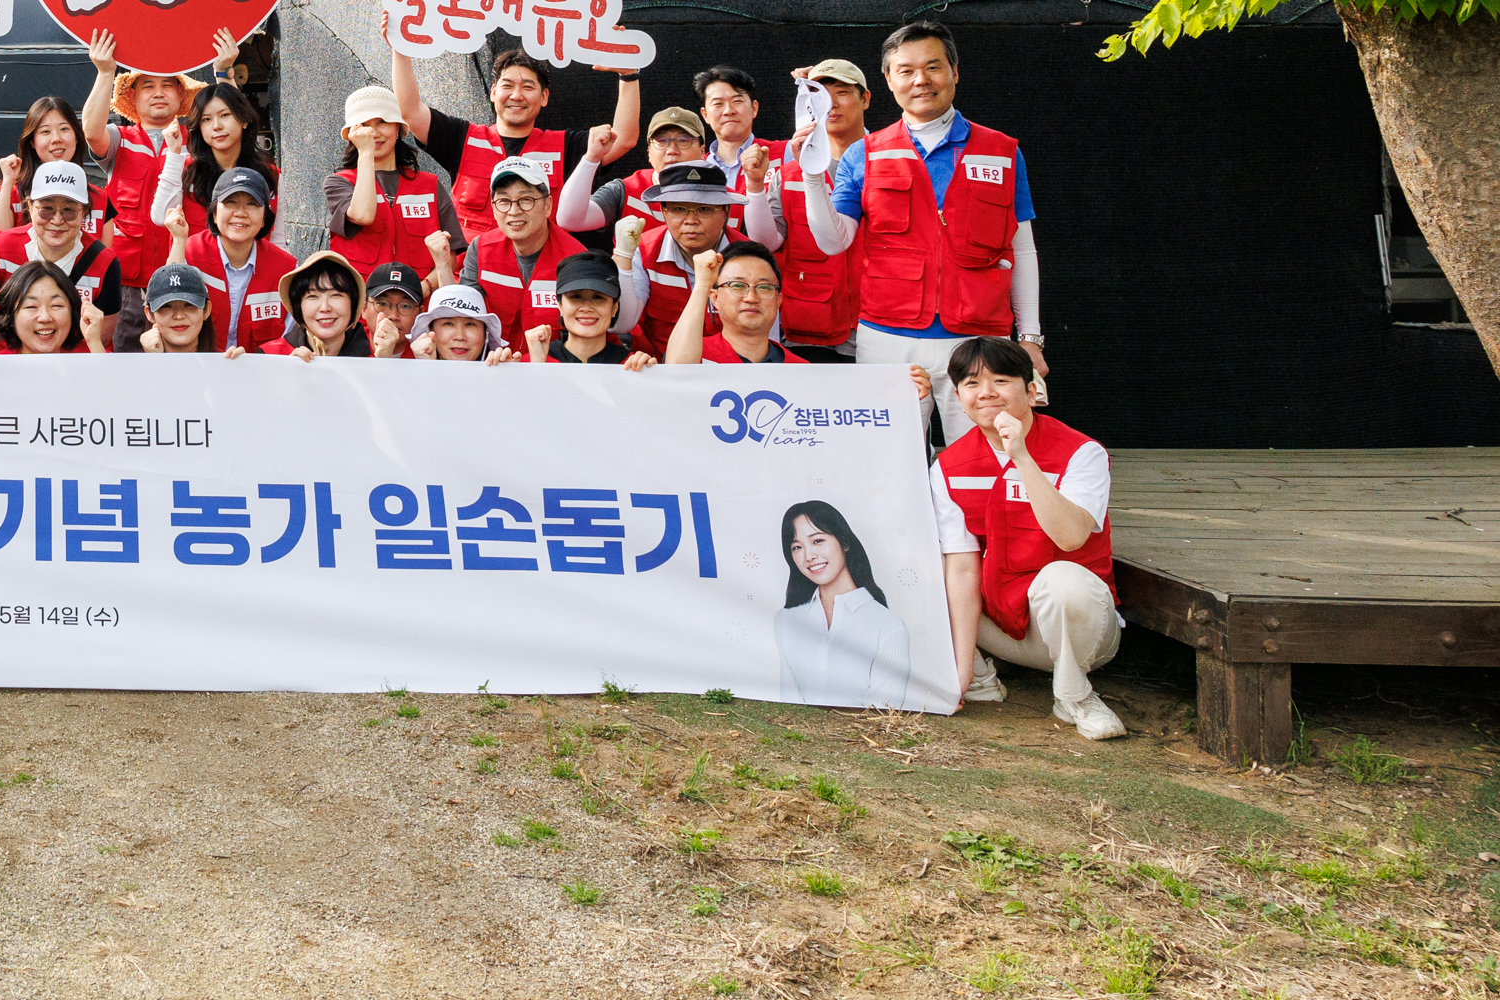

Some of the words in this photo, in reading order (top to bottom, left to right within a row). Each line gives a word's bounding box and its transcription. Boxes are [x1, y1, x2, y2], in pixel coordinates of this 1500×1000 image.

[45, 174, 76, 185] Volvik
[982, 168, 999, 181] 듀오
[413, 206, 427, 215] 듀오
[169, 274, 181, 286] NY
[264, 305, 278, 315] 듀오
[710, 390, 788, 443] 30
[794, 408, 830, 427] 창립
[832, 408, 891, 428] 30주년
[29, 417, 115, 447] 사랑이
[124, 418, 213, 448] 됩니다
[782, 428, 818, 436] Since1995
[170, 480, 342, 568] 농가
[368, 483, 718, 579] 일손돕기
[0, 605, 31, 625] 5월
[37, 606, 79, 626] 14일
[85, 606, 120, 627] (수)
